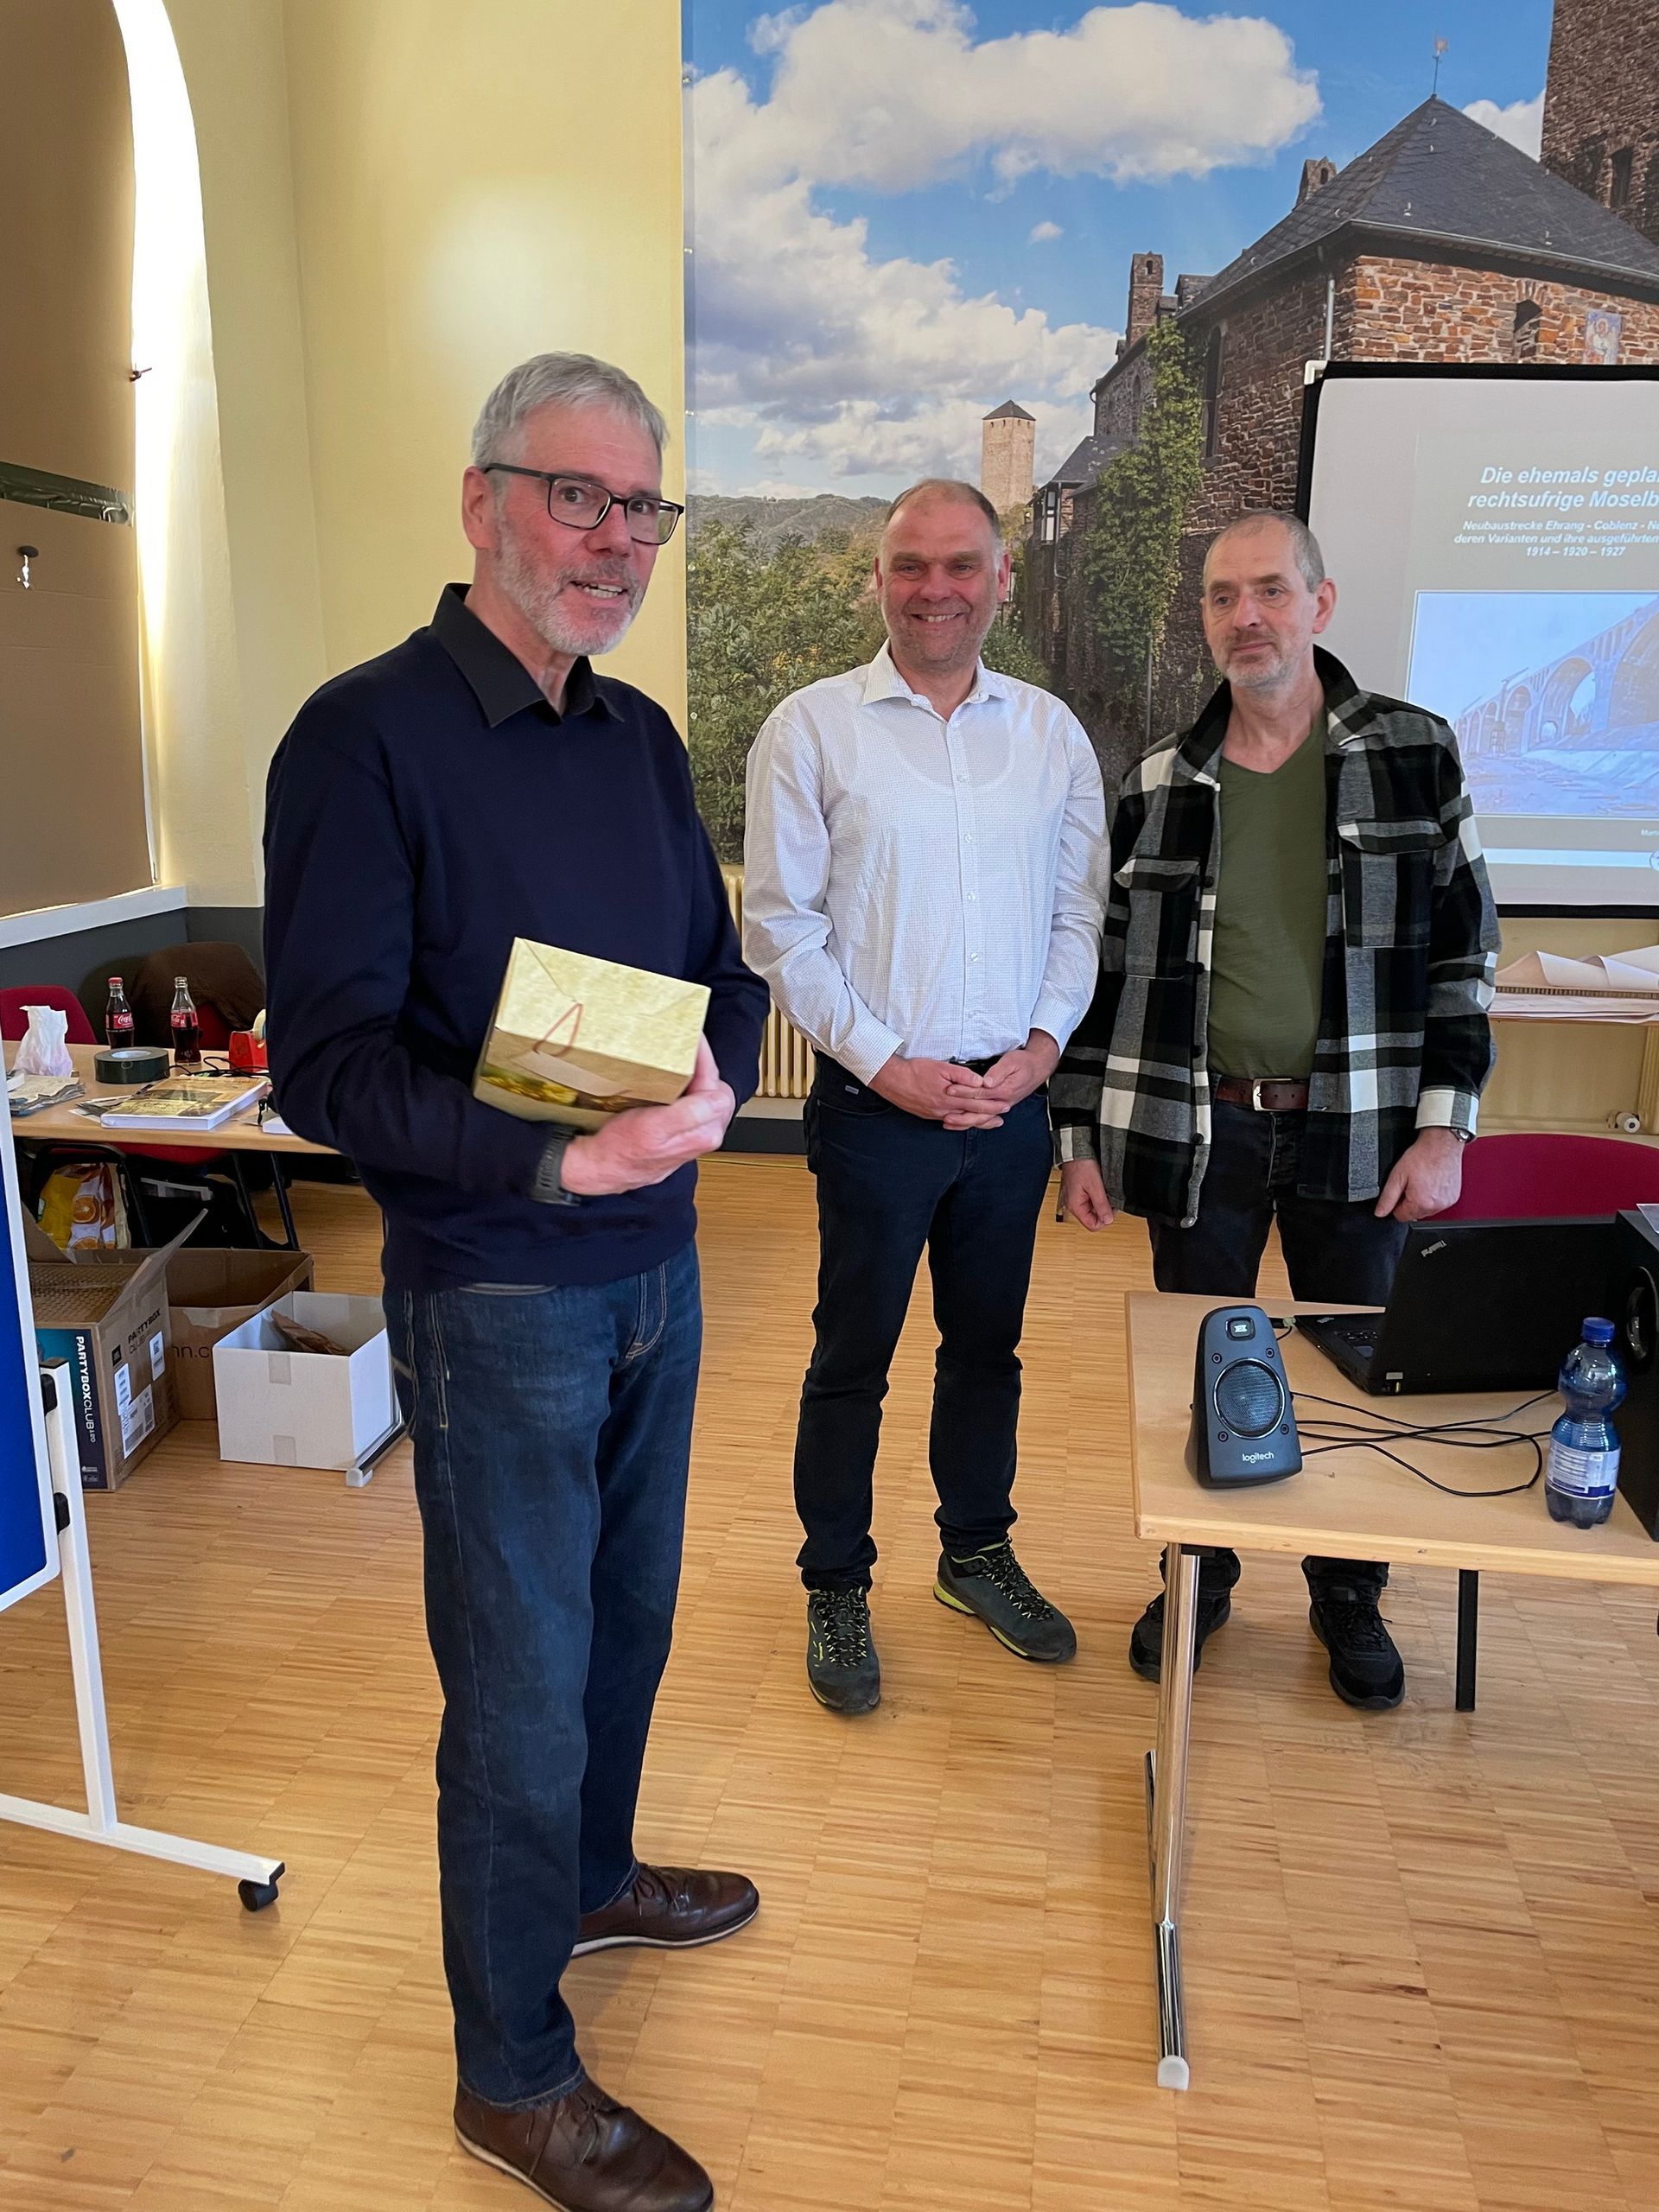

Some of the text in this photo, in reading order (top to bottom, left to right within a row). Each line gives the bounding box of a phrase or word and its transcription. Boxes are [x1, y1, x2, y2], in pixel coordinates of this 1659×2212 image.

[1480, 466, 1659, 487] Die ehemals gepla
[1467, 491, 1585, 512] rechtsufrige
[1463, 521, 1542, 531] Neubaustrecke
[1545, 520, 1585, 532] Ehrang
[1593, 520, 1638, 531] Coblenz
[1453, 533, 1484, 543] deren
[1488, 533, 1538, 543] Varianten
[1541, 533, 1560, 543] und
[1564, 533, 1585, 543] ihre
[1526, 546, 1551, 556] 1914
[1562, 546, 1588, 556] 1920
[1600, 546, 1626, 556] 1927
[1242, 1451, 1274, 1464] logitech
